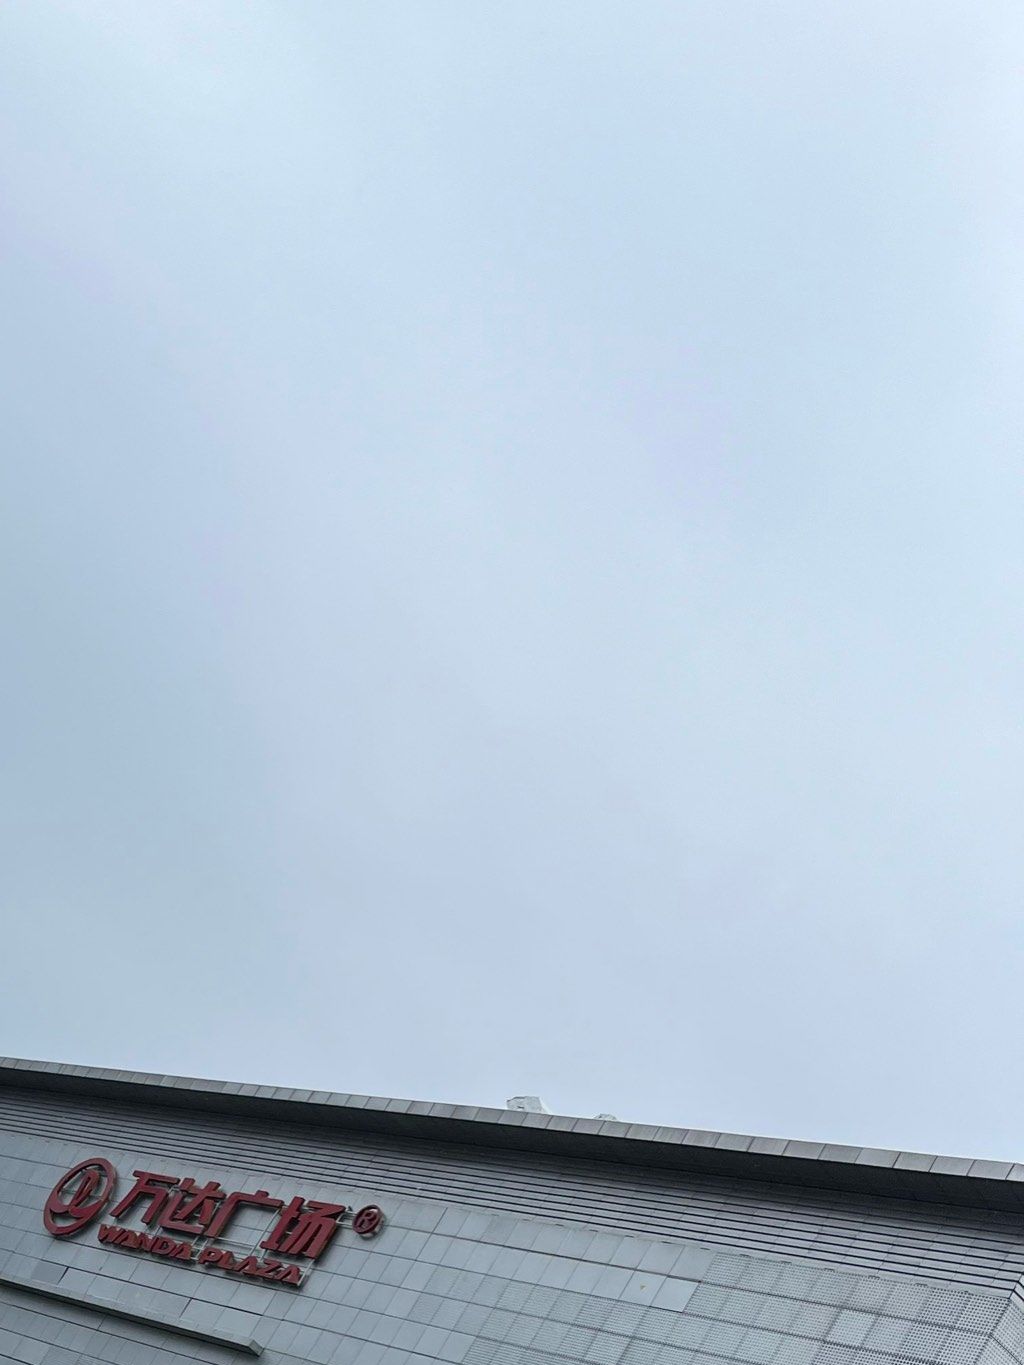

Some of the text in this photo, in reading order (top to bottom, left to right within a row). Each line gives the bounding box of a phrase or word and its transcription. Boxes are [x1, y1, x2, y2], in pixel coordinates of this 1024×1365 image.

[109, 1170, 347, 1260] 万达广场
[97, 1224, 302, 1286] WANDA PLAZA
